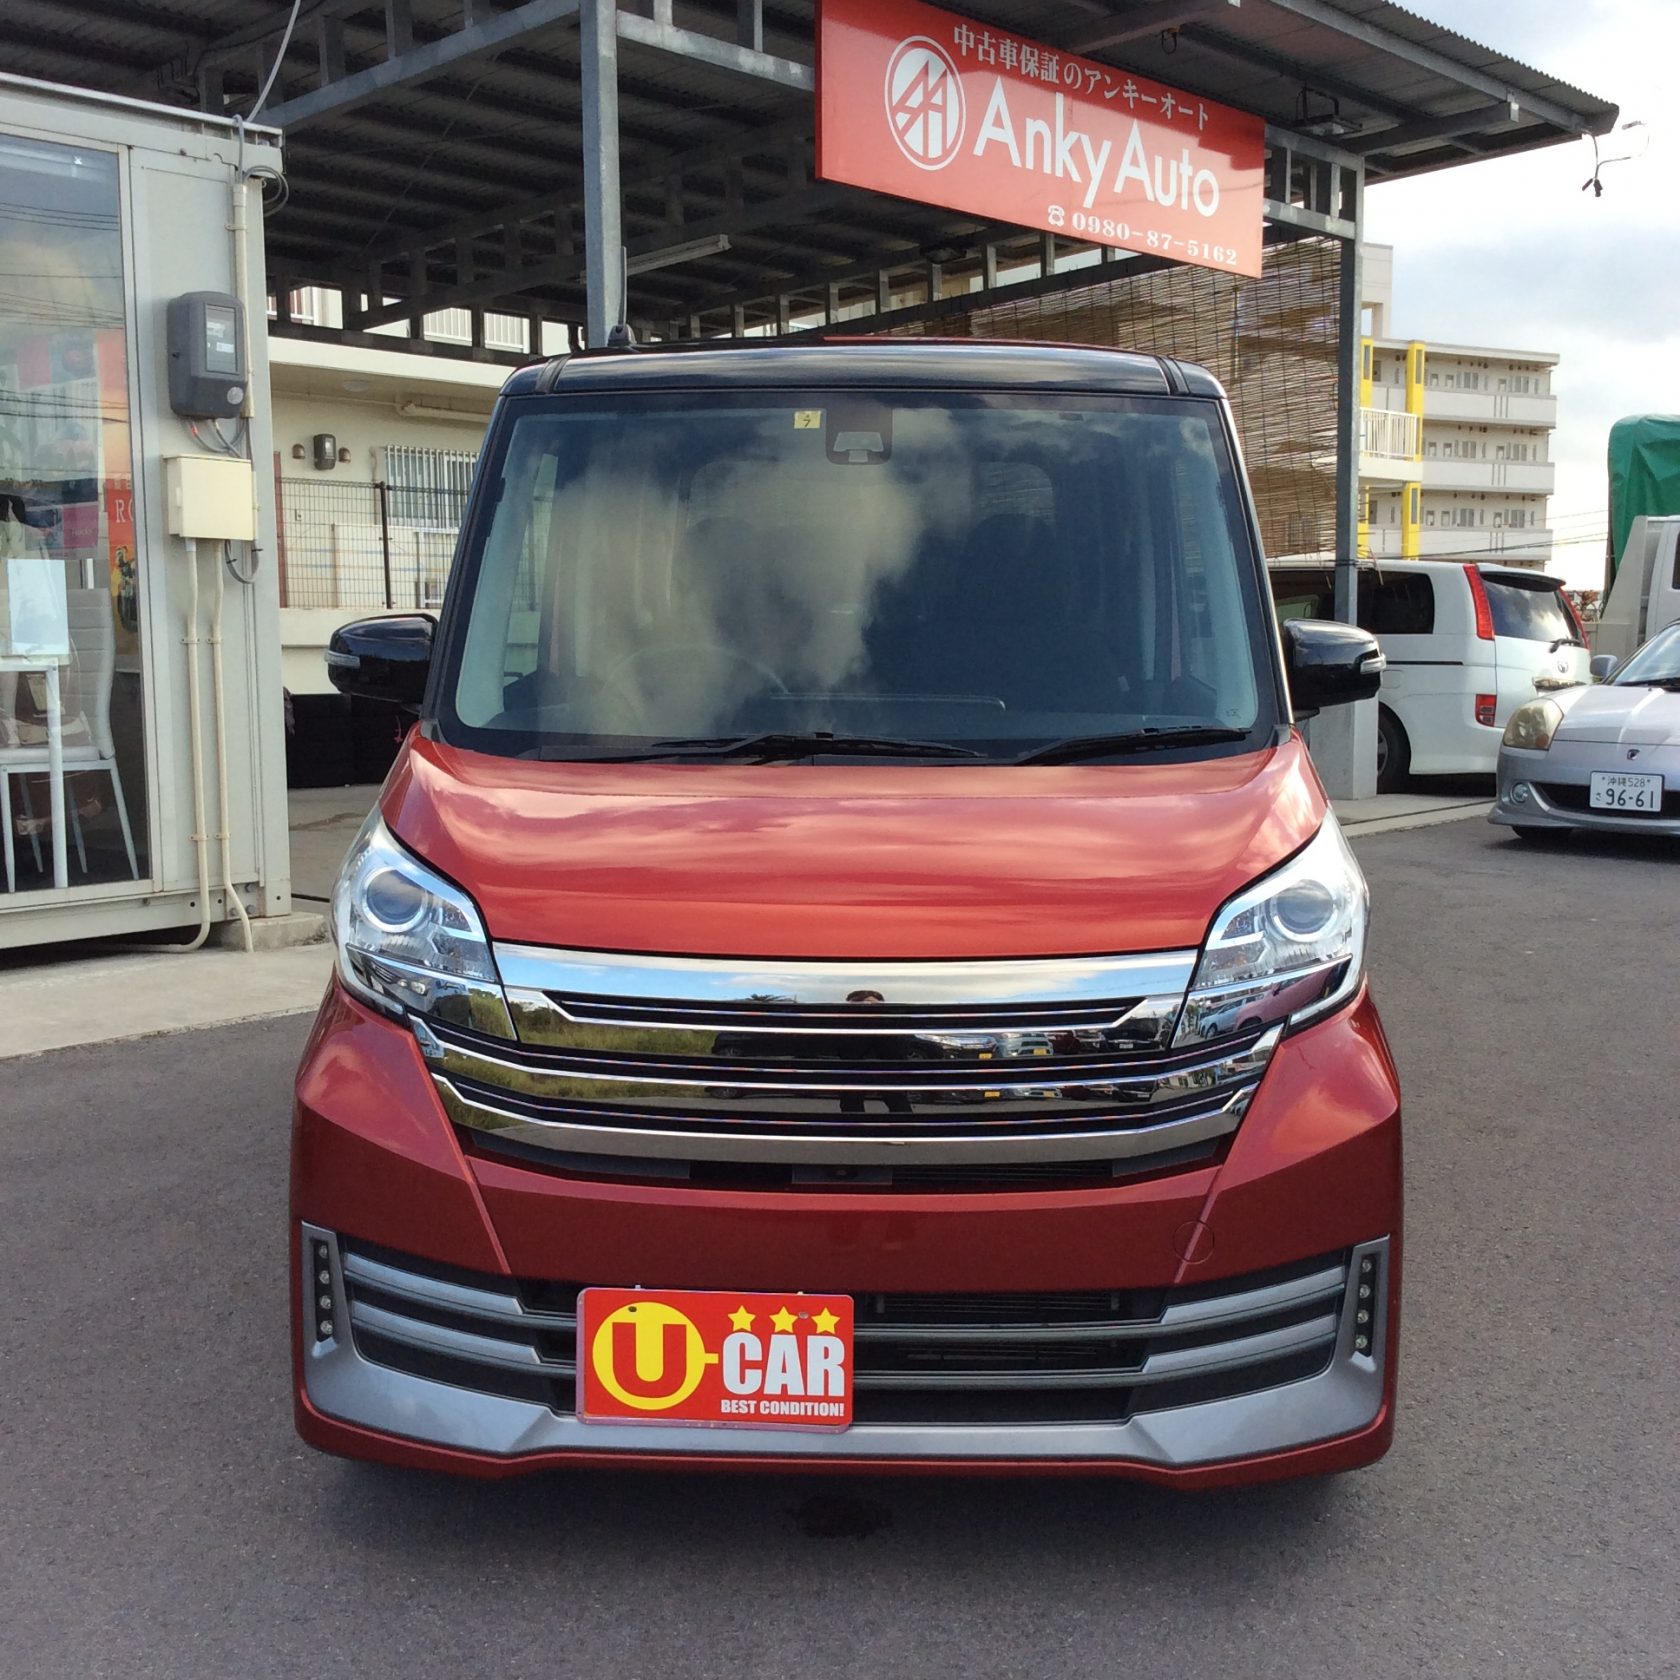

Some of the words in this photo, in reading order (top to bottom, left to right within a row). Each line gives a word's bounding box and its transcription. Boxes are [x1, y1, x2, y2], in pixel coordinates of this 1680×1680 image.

[953, 23, 1209, 131] 中古車保証のアンキーオート
[973, 75, 1112, 209] Anky
[1114, 118, 1220, 218] Auto
[1072, 212, 1238, 266] 0980-87-5162
[1605, 788, 1654, 809] 96-61
[722, 1331, 846, 1397] CAR
[720, 1399, 756, 1415] BEST
[759, 1400, 845, 1417] CONDITION!
